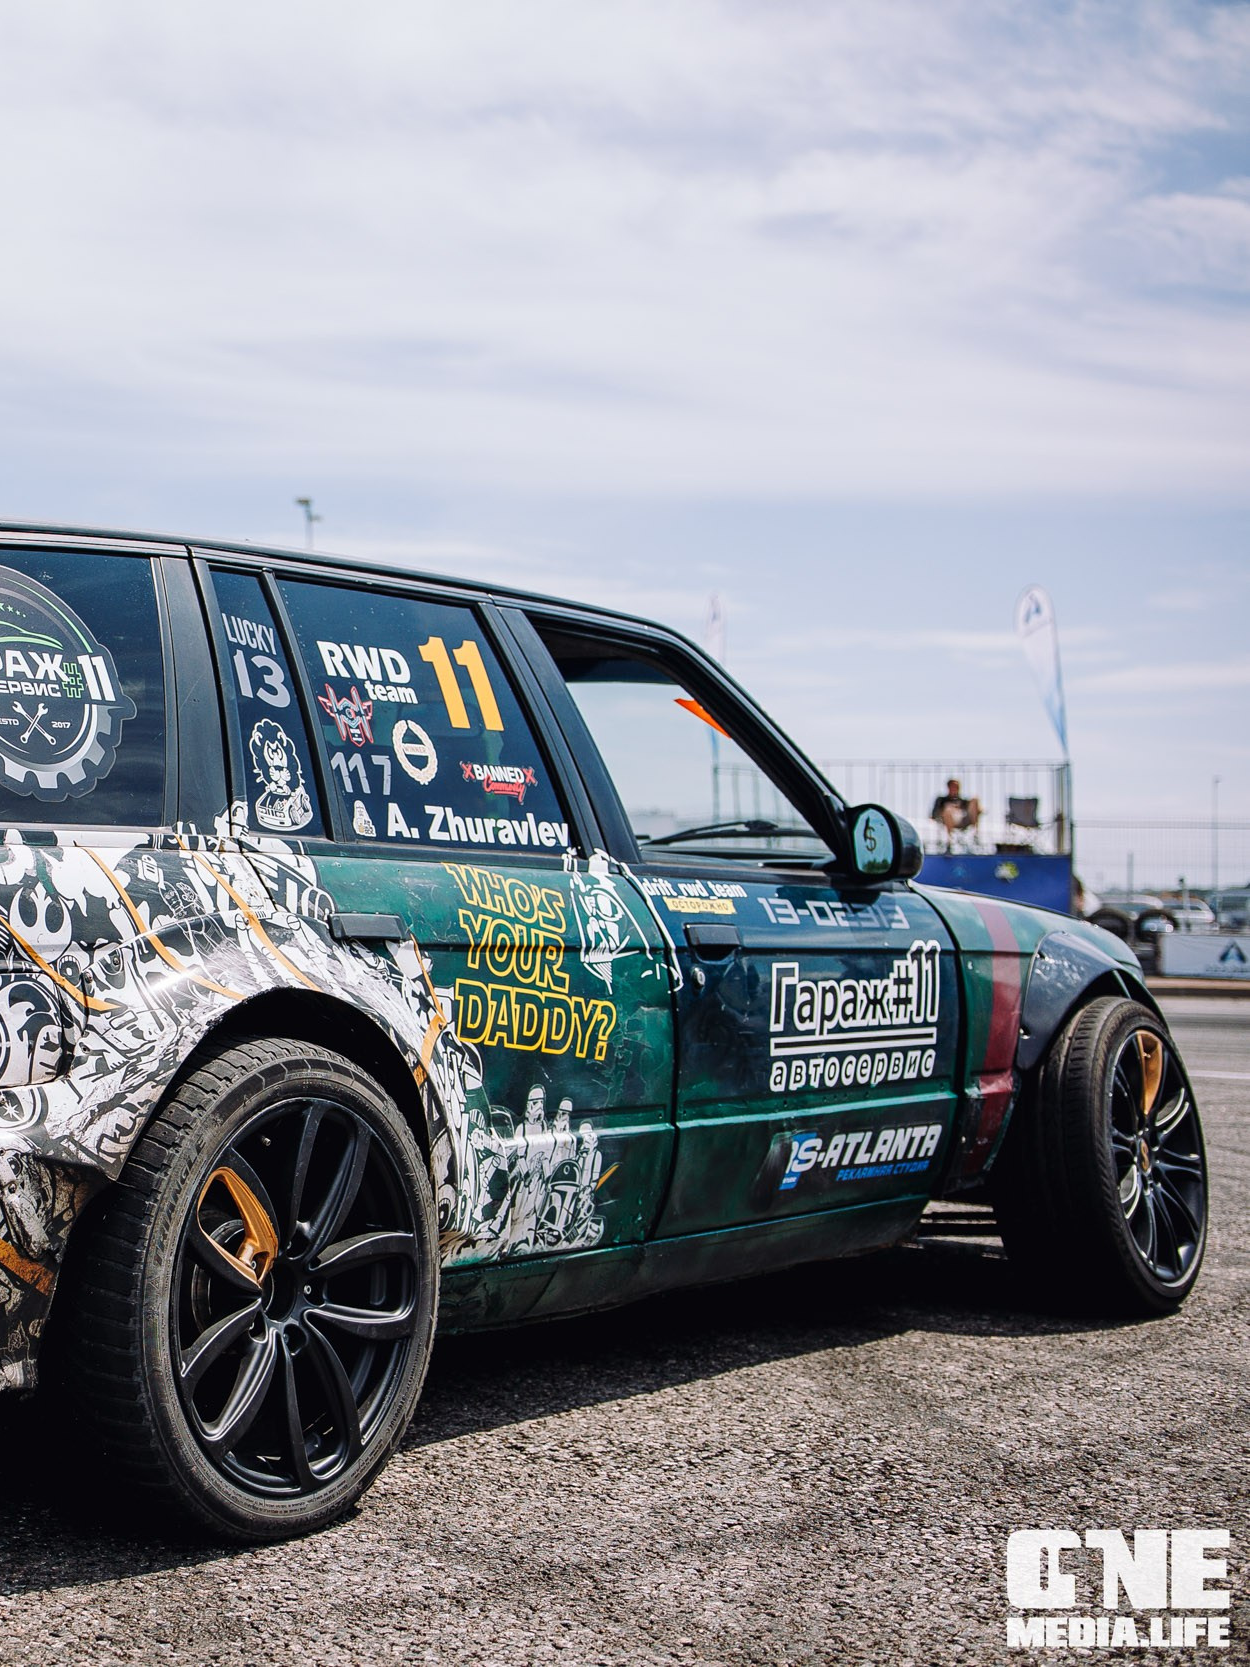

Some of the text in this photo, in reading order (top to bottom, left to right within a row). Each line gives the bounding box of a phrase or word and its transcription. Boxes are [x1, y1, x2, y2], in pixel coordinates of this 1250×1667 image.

[221, 612, 277, 655] LUCKY
[233, 649, 291, 708] 13
[316, 640, 411, 684] RWD
[417, 636, 505, 732] 11
[364, 680, 419, 704] team
[51, 720, 71, 730] 2017
[387, 802, 420, 839] A.
[424, 804, 569, 848] Zhuravlev
[442, 862, 567, 934] WHO'S
[670, 899, 730, 911] ОСТОРОЖНО
[458, 908, 570, 994] YOUR
[455, 977, 617, 1061] DADDY?
[770, 1049, 937, 1092] автосервис
